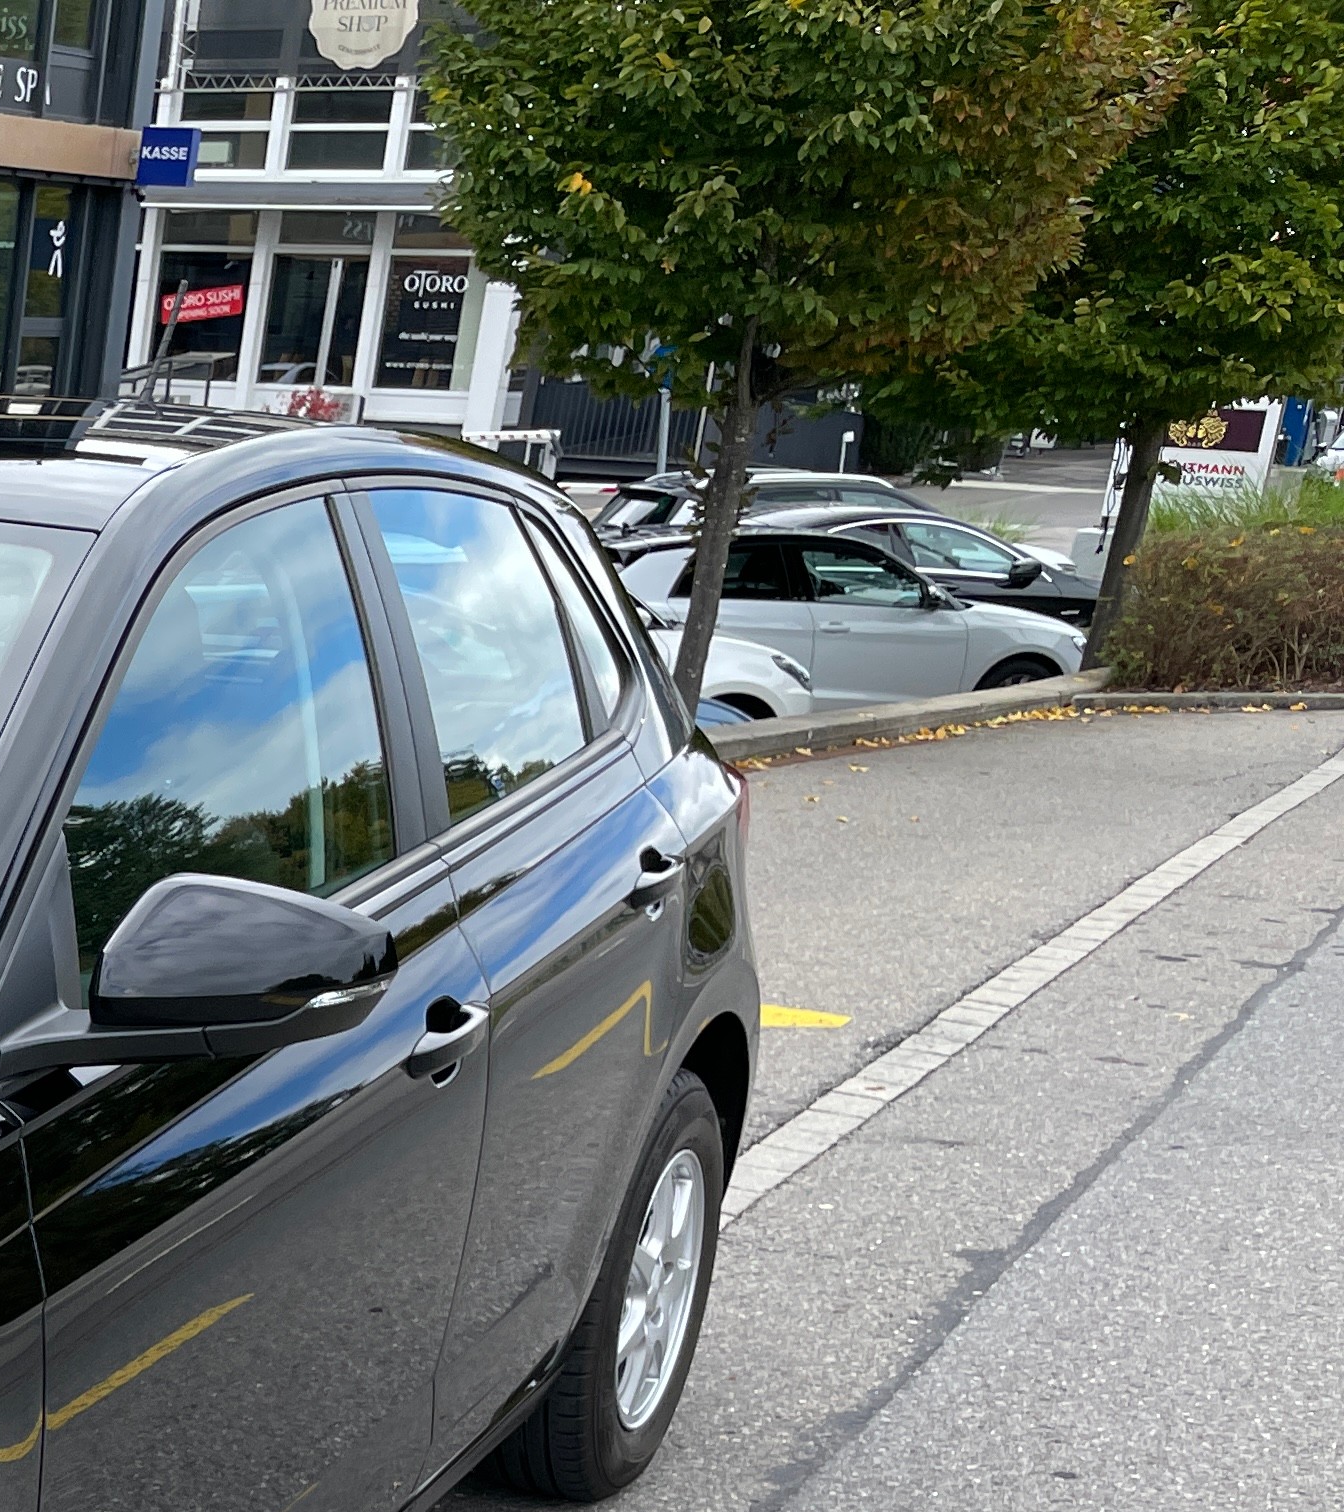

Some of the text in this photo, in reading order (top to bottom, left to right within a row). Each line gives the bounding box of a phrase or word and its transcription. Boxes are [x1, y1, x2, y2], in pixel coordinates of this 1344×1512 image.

[141, 144, 188, 161] KASSE
[404, 270, 469, 298] OTORO
[163, 288, 241, 311] OORO SUSHI
[413, 300, 455, 309] SUSHI
